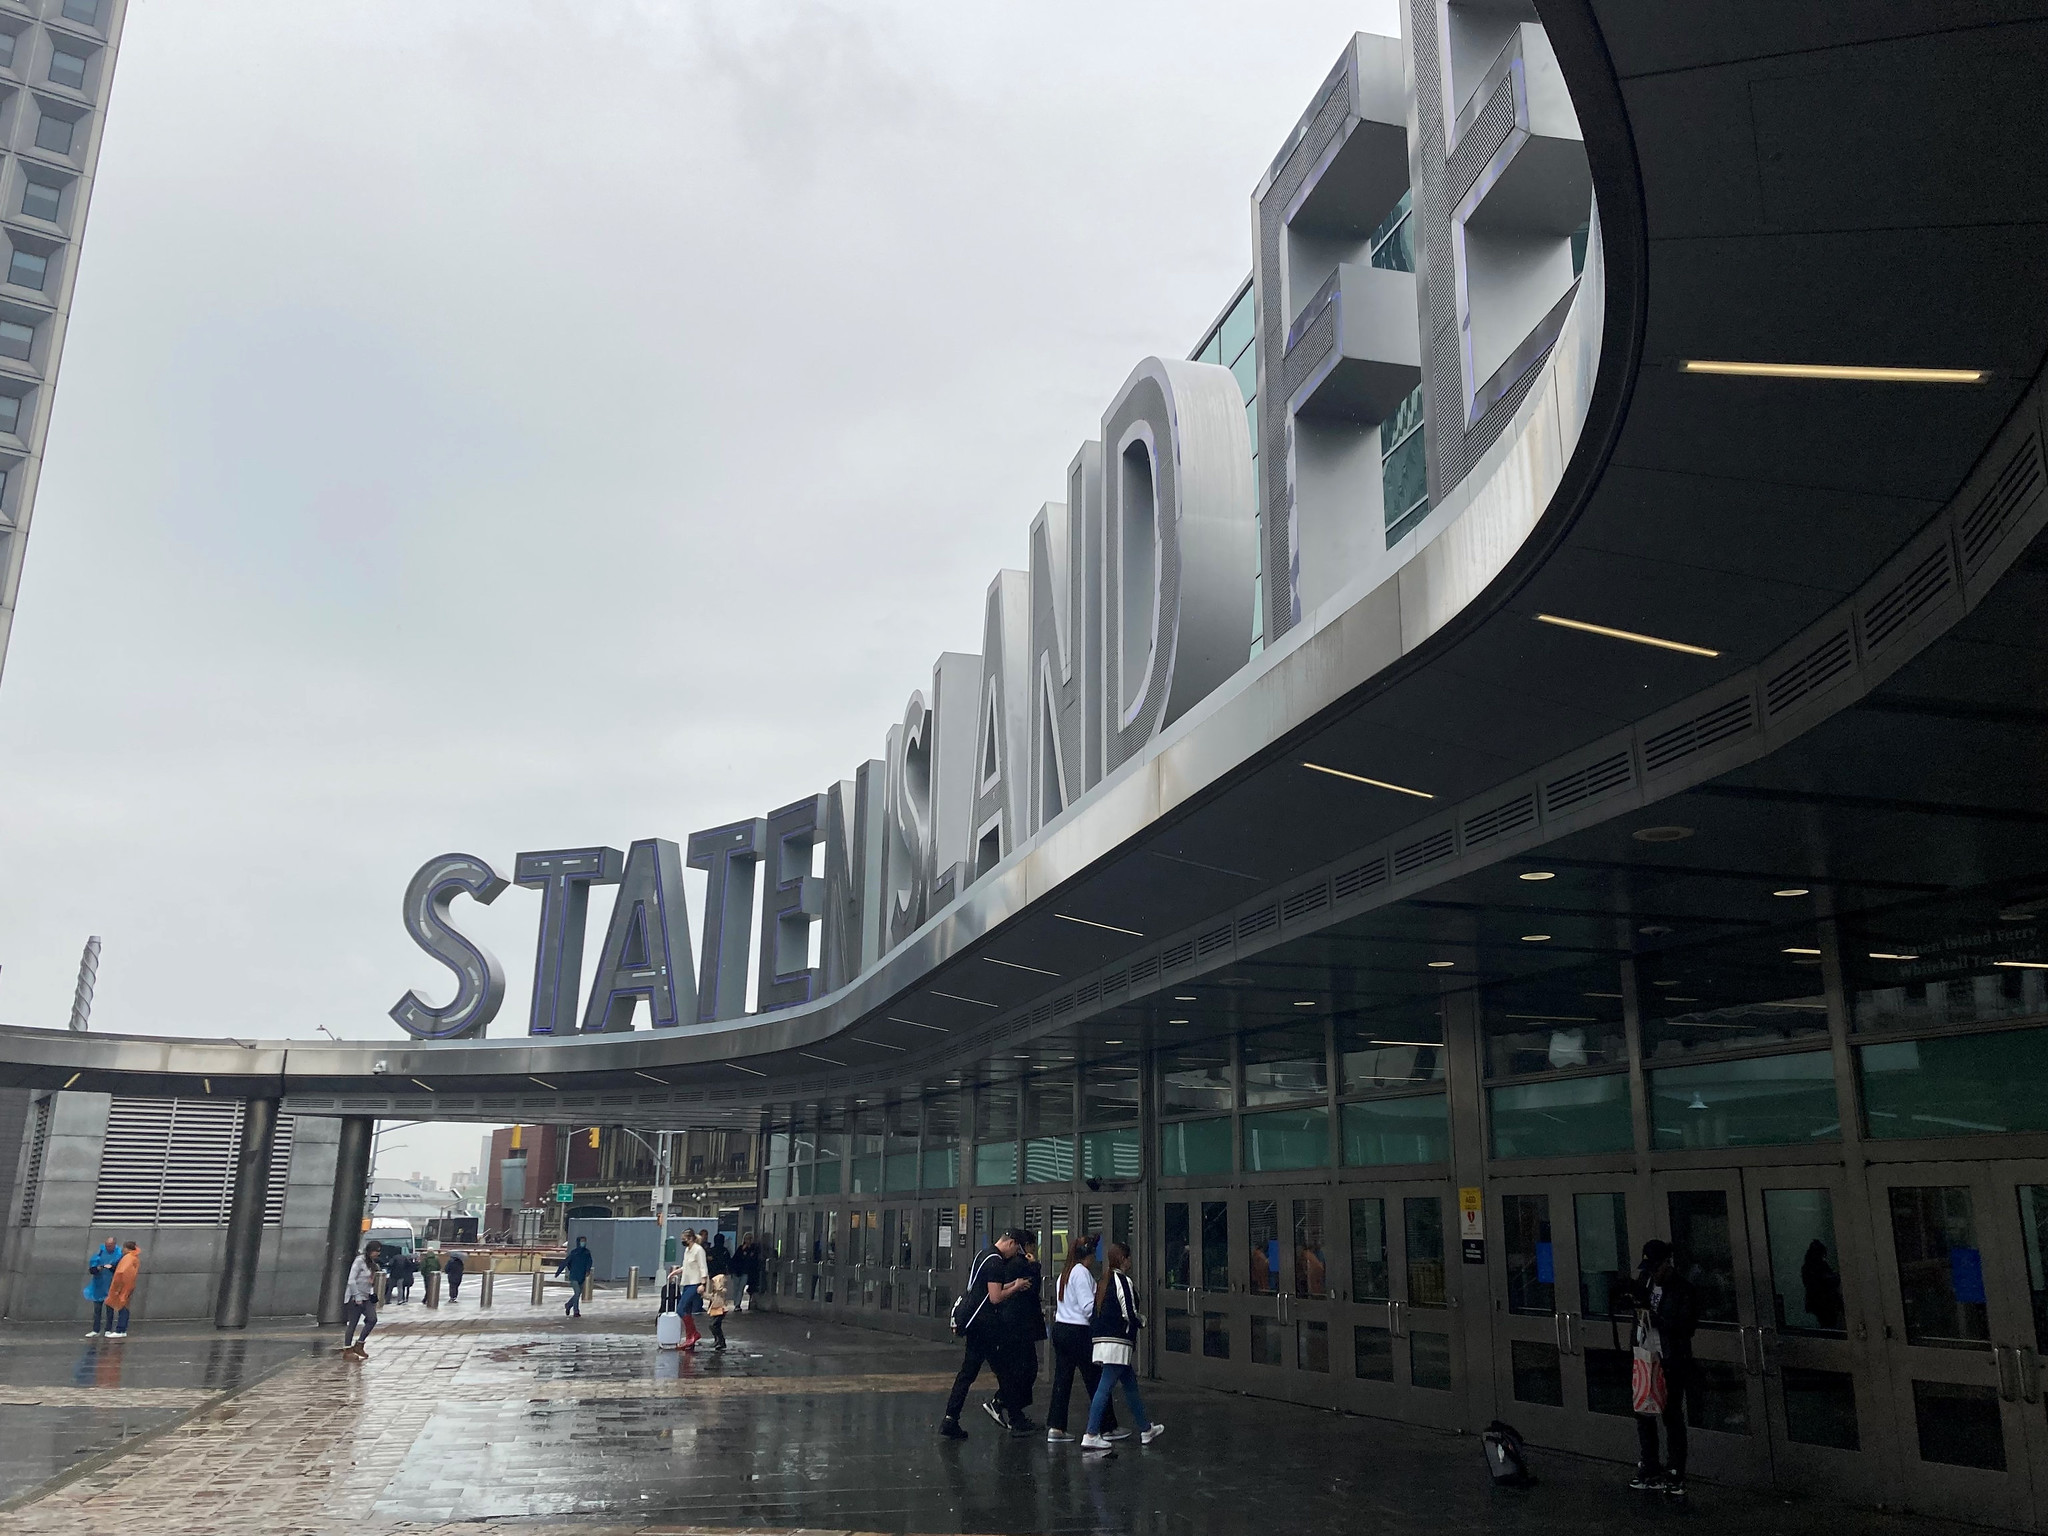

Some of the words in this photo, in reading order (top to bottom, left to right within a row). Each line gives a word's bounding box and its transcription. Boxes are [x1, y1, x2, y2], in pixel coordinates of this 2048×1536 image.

[387, 759, 885, 1040] STATEN
[885, 356, 1254, 958] ISLAND
[1944, 930, 1992, 950] Island
[1996, 926, 2039, 942] Ferry
[1898, 955, 1969, 978] Whitehall
